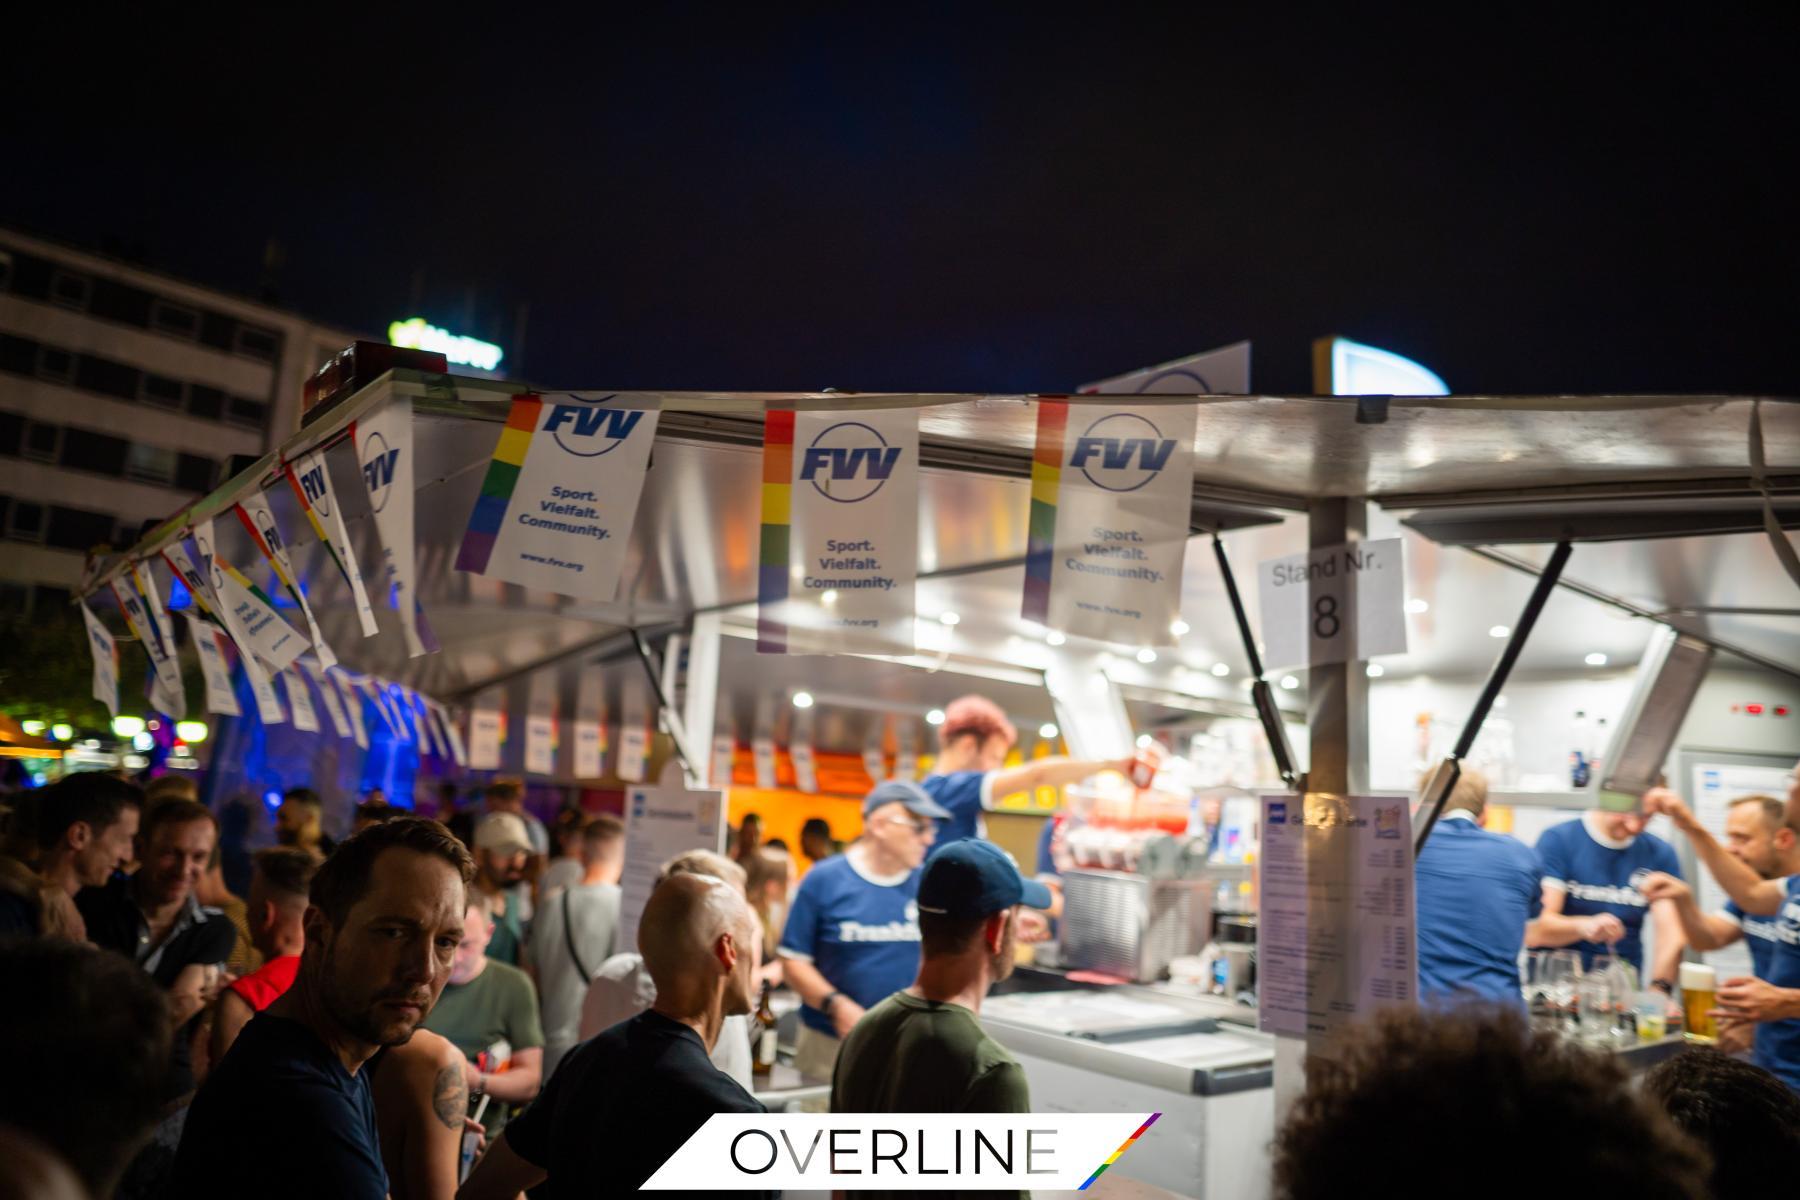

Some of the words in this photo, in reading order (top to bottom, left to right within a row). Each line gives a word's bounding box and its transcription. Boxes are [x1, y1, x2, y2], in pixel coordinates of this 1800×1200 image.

[542, 404, 644, 440] FVV
[800, 447, 902, 481] FVV
[1069, 437, 1178, 472] FVV
[551, 485, 598, 502] Sport.
[540, 500, 600, 520] Vielfalt.
[518, 513, 611, 541] Community.
[1092, 527, 1144, 542] Sport.
[826, 540, 876, 554] Sport.
[1083, 543, 1149, 561] Vielfalt.
[520, 552, 584, 572] www.fvv.org
[819, 558, 882, 570] Vielfalt.
[1065, 557, 1165, 584] Community.
[1272, 553, 1337, 588] Stand
[1344, 550, 1383, 572] Nr.
[803, 576, 898, 591] Community.
[1314, 595, 1340, 639] 8
